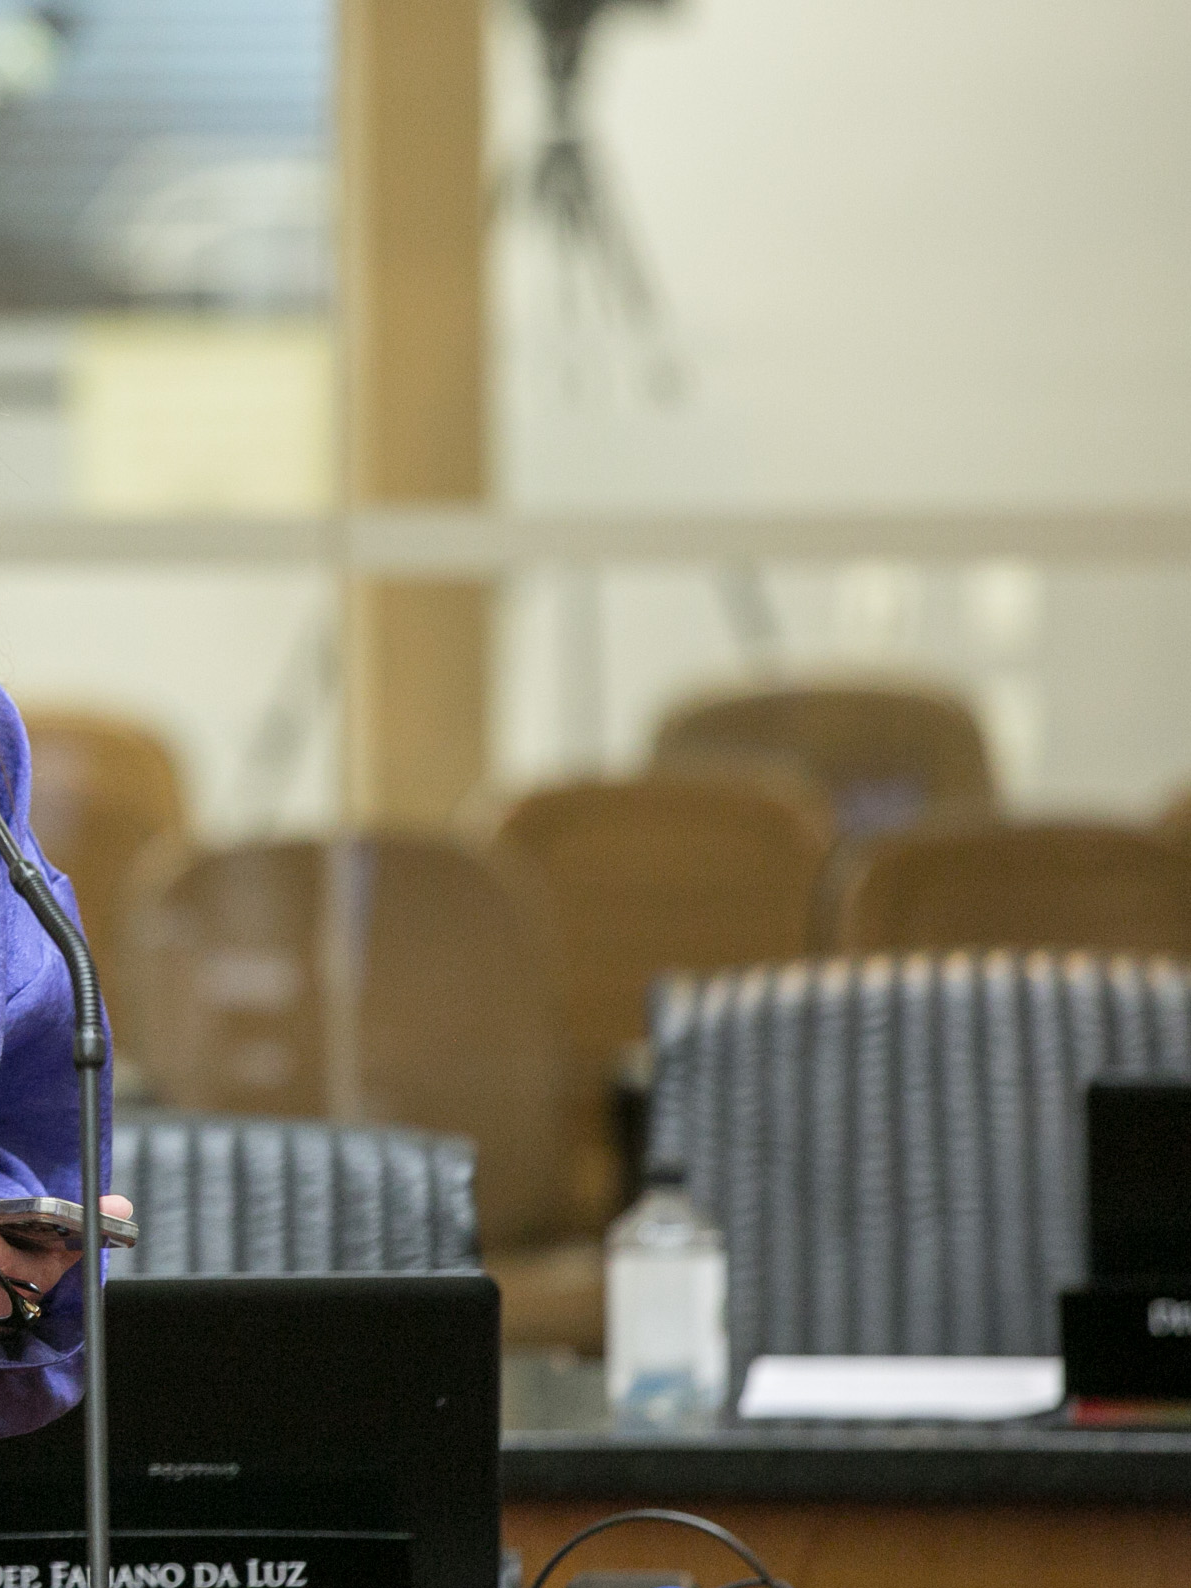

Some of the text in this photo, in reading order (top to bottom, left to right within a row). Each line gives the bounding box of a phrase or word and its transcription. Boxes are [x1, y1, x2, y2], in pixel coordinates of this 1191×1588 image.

[49, 1561, 186, 1588] FAANO
[193, 1562, 240, 1588] DA
[246, 1558, 308, 1588] LUZ
